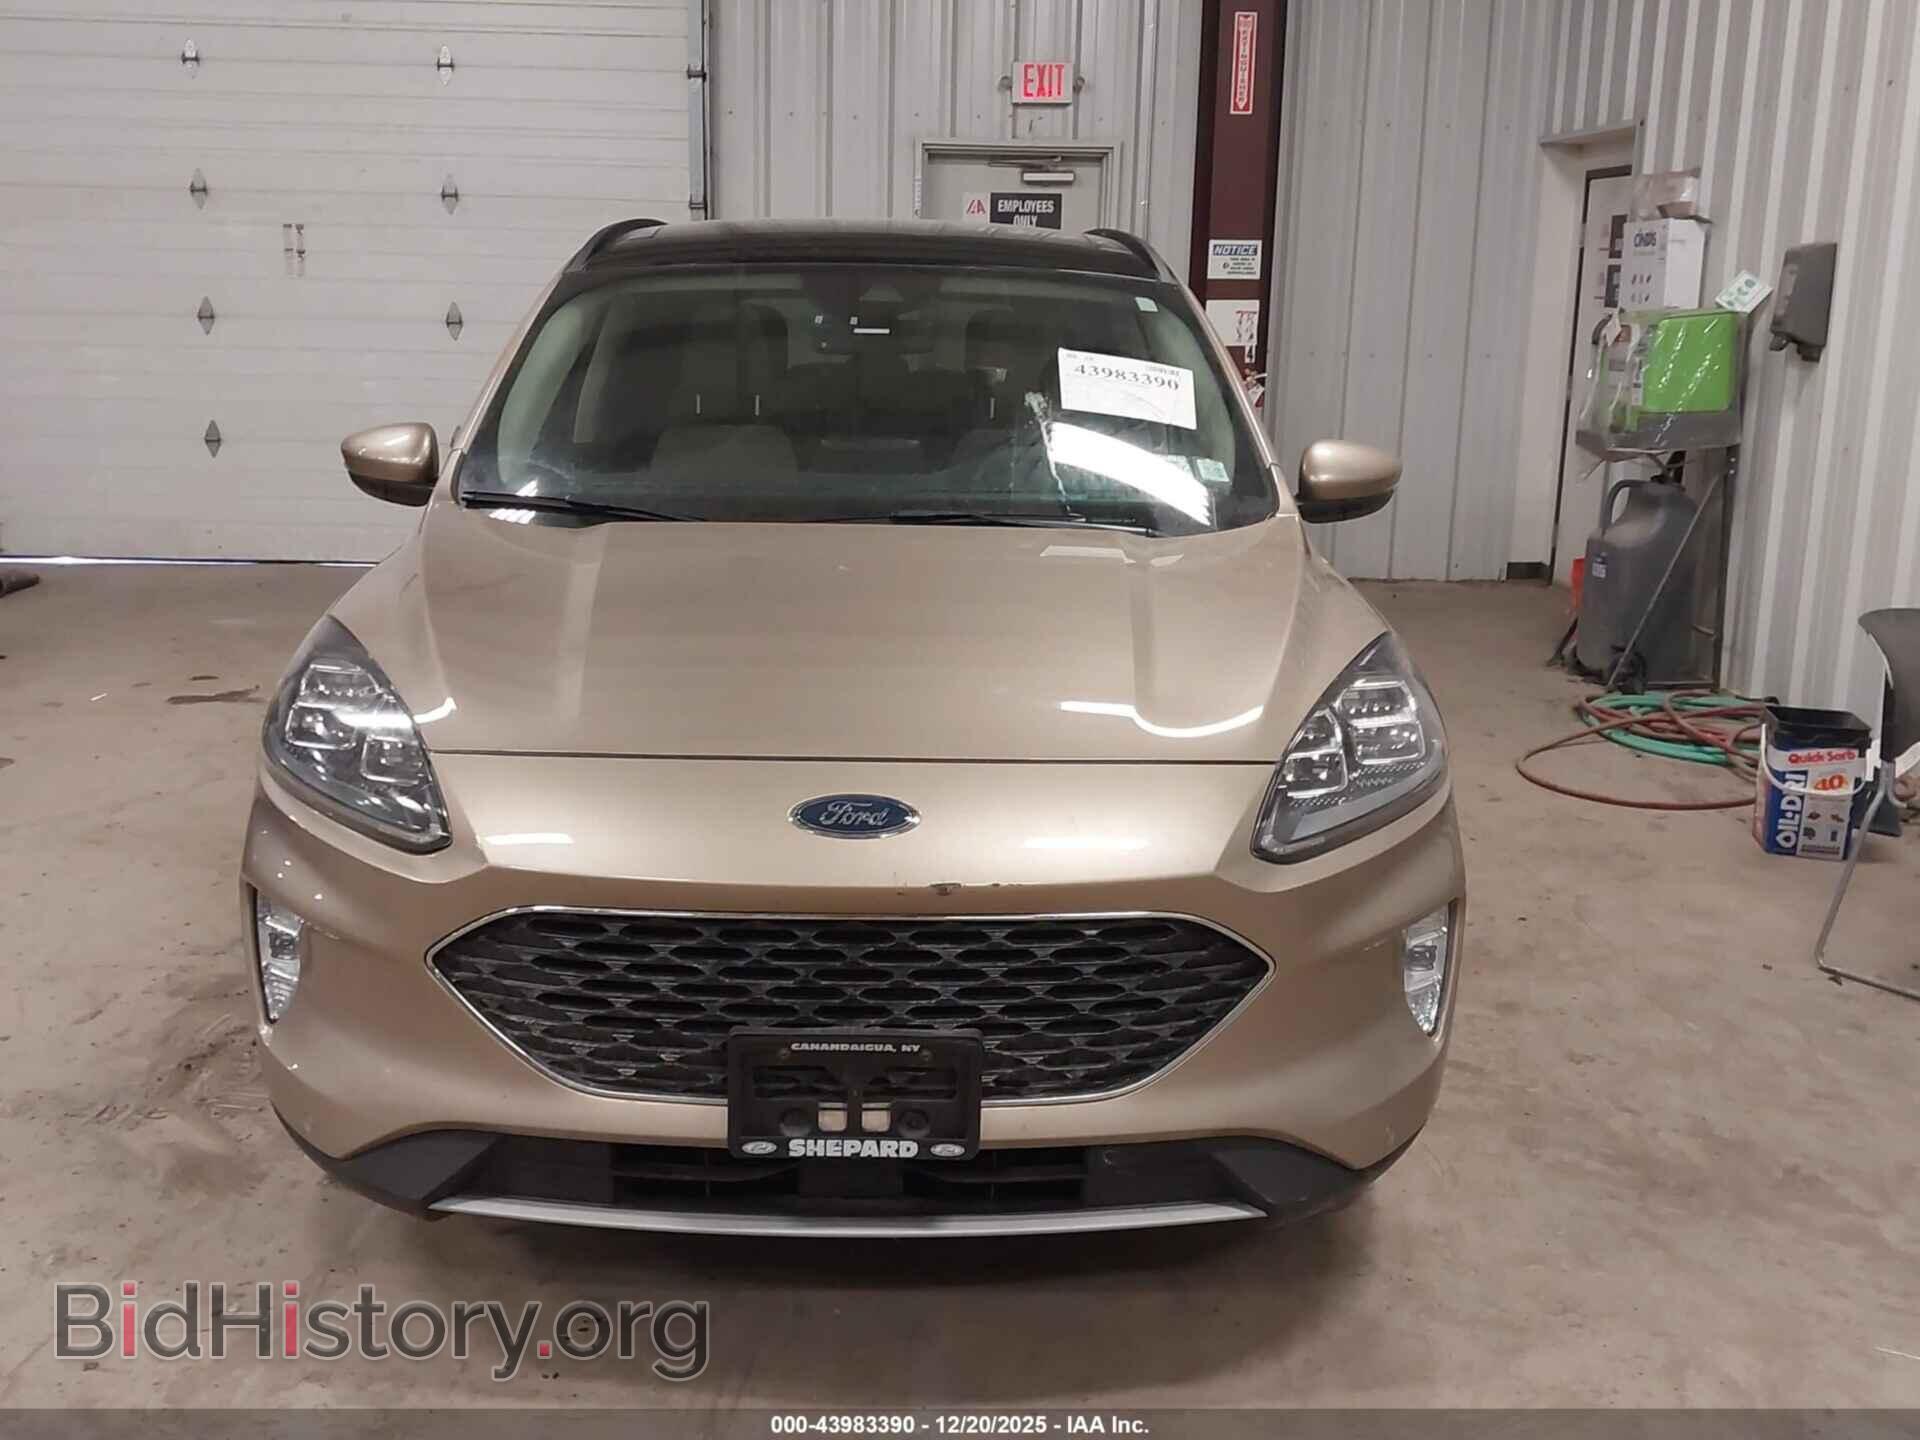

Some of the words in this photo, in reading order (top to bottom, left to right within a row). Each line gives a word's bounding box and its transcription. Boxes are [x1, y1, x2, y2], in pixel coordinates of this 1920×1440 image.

[1023, 64, 1065, 98] EXIT
[998, 199, 1055, 213] EMPLOYEES
[1013, 215, 1038, 227] ONLY
[1214, 245, 1257, 255] NOTICE
[1074, 364, 1179, 391] 43983390
[1788, 752, 1824, 764] Quick
[1827, 750, 1857, 762] Sorb
[819, 801, 890, 826] Ford
[791, 1043, 896, 1053] CANANDAIGUA,
[901, 1044, 920, 1053] NY
[788, 1139, 919, 1158] SHEPARD
